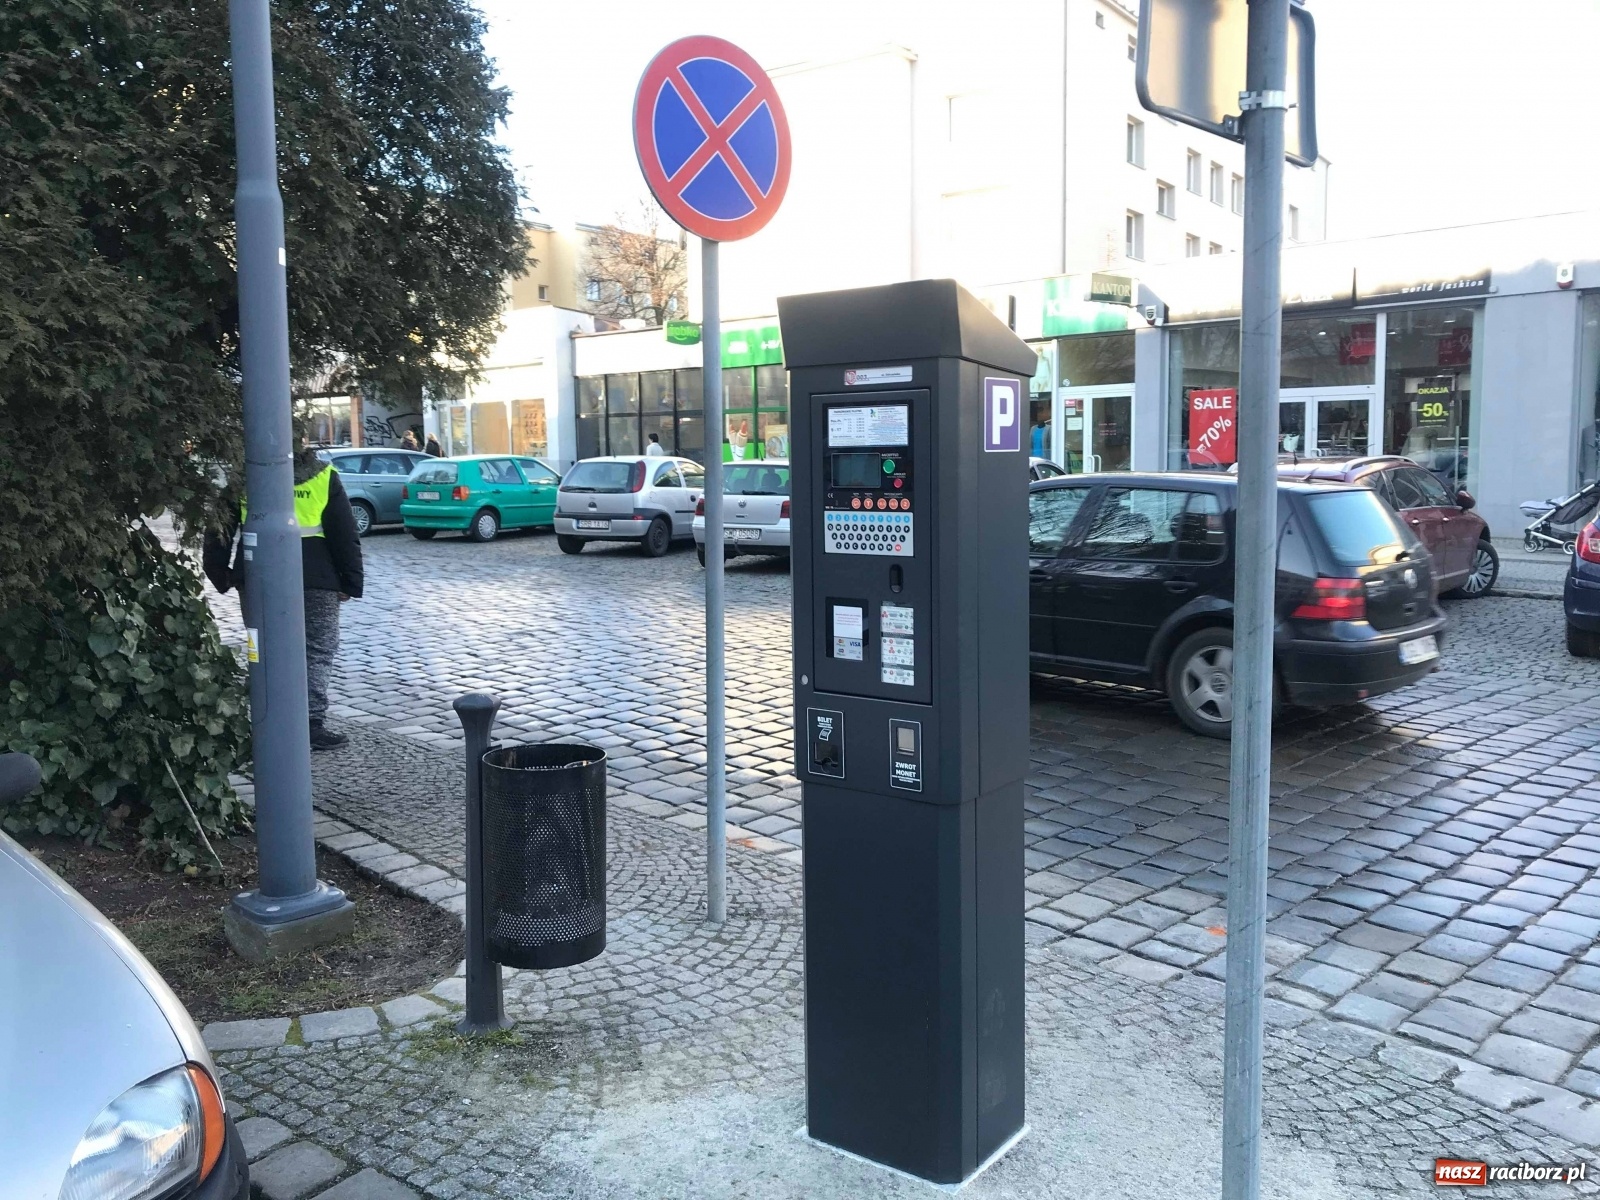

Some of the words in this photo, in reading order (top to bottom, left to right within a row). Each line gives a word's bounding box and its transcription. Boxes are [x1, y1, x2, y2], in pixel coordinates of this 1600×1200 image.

[1092, 281, 1131, 297] KANTOR
[1401, 281, 1434, 294] world
[1438, 278, 1485, 292] fashion
[1418, 386, 1449, 395] OKAZJA
[1193, 396, 1232, 410] SALE
[992, 385, 1015, 445] P
[817, 716, 833, 724] BILET
[895, 761, 917, 771] ZWROT
[895, 769, 917, 778] MONET
